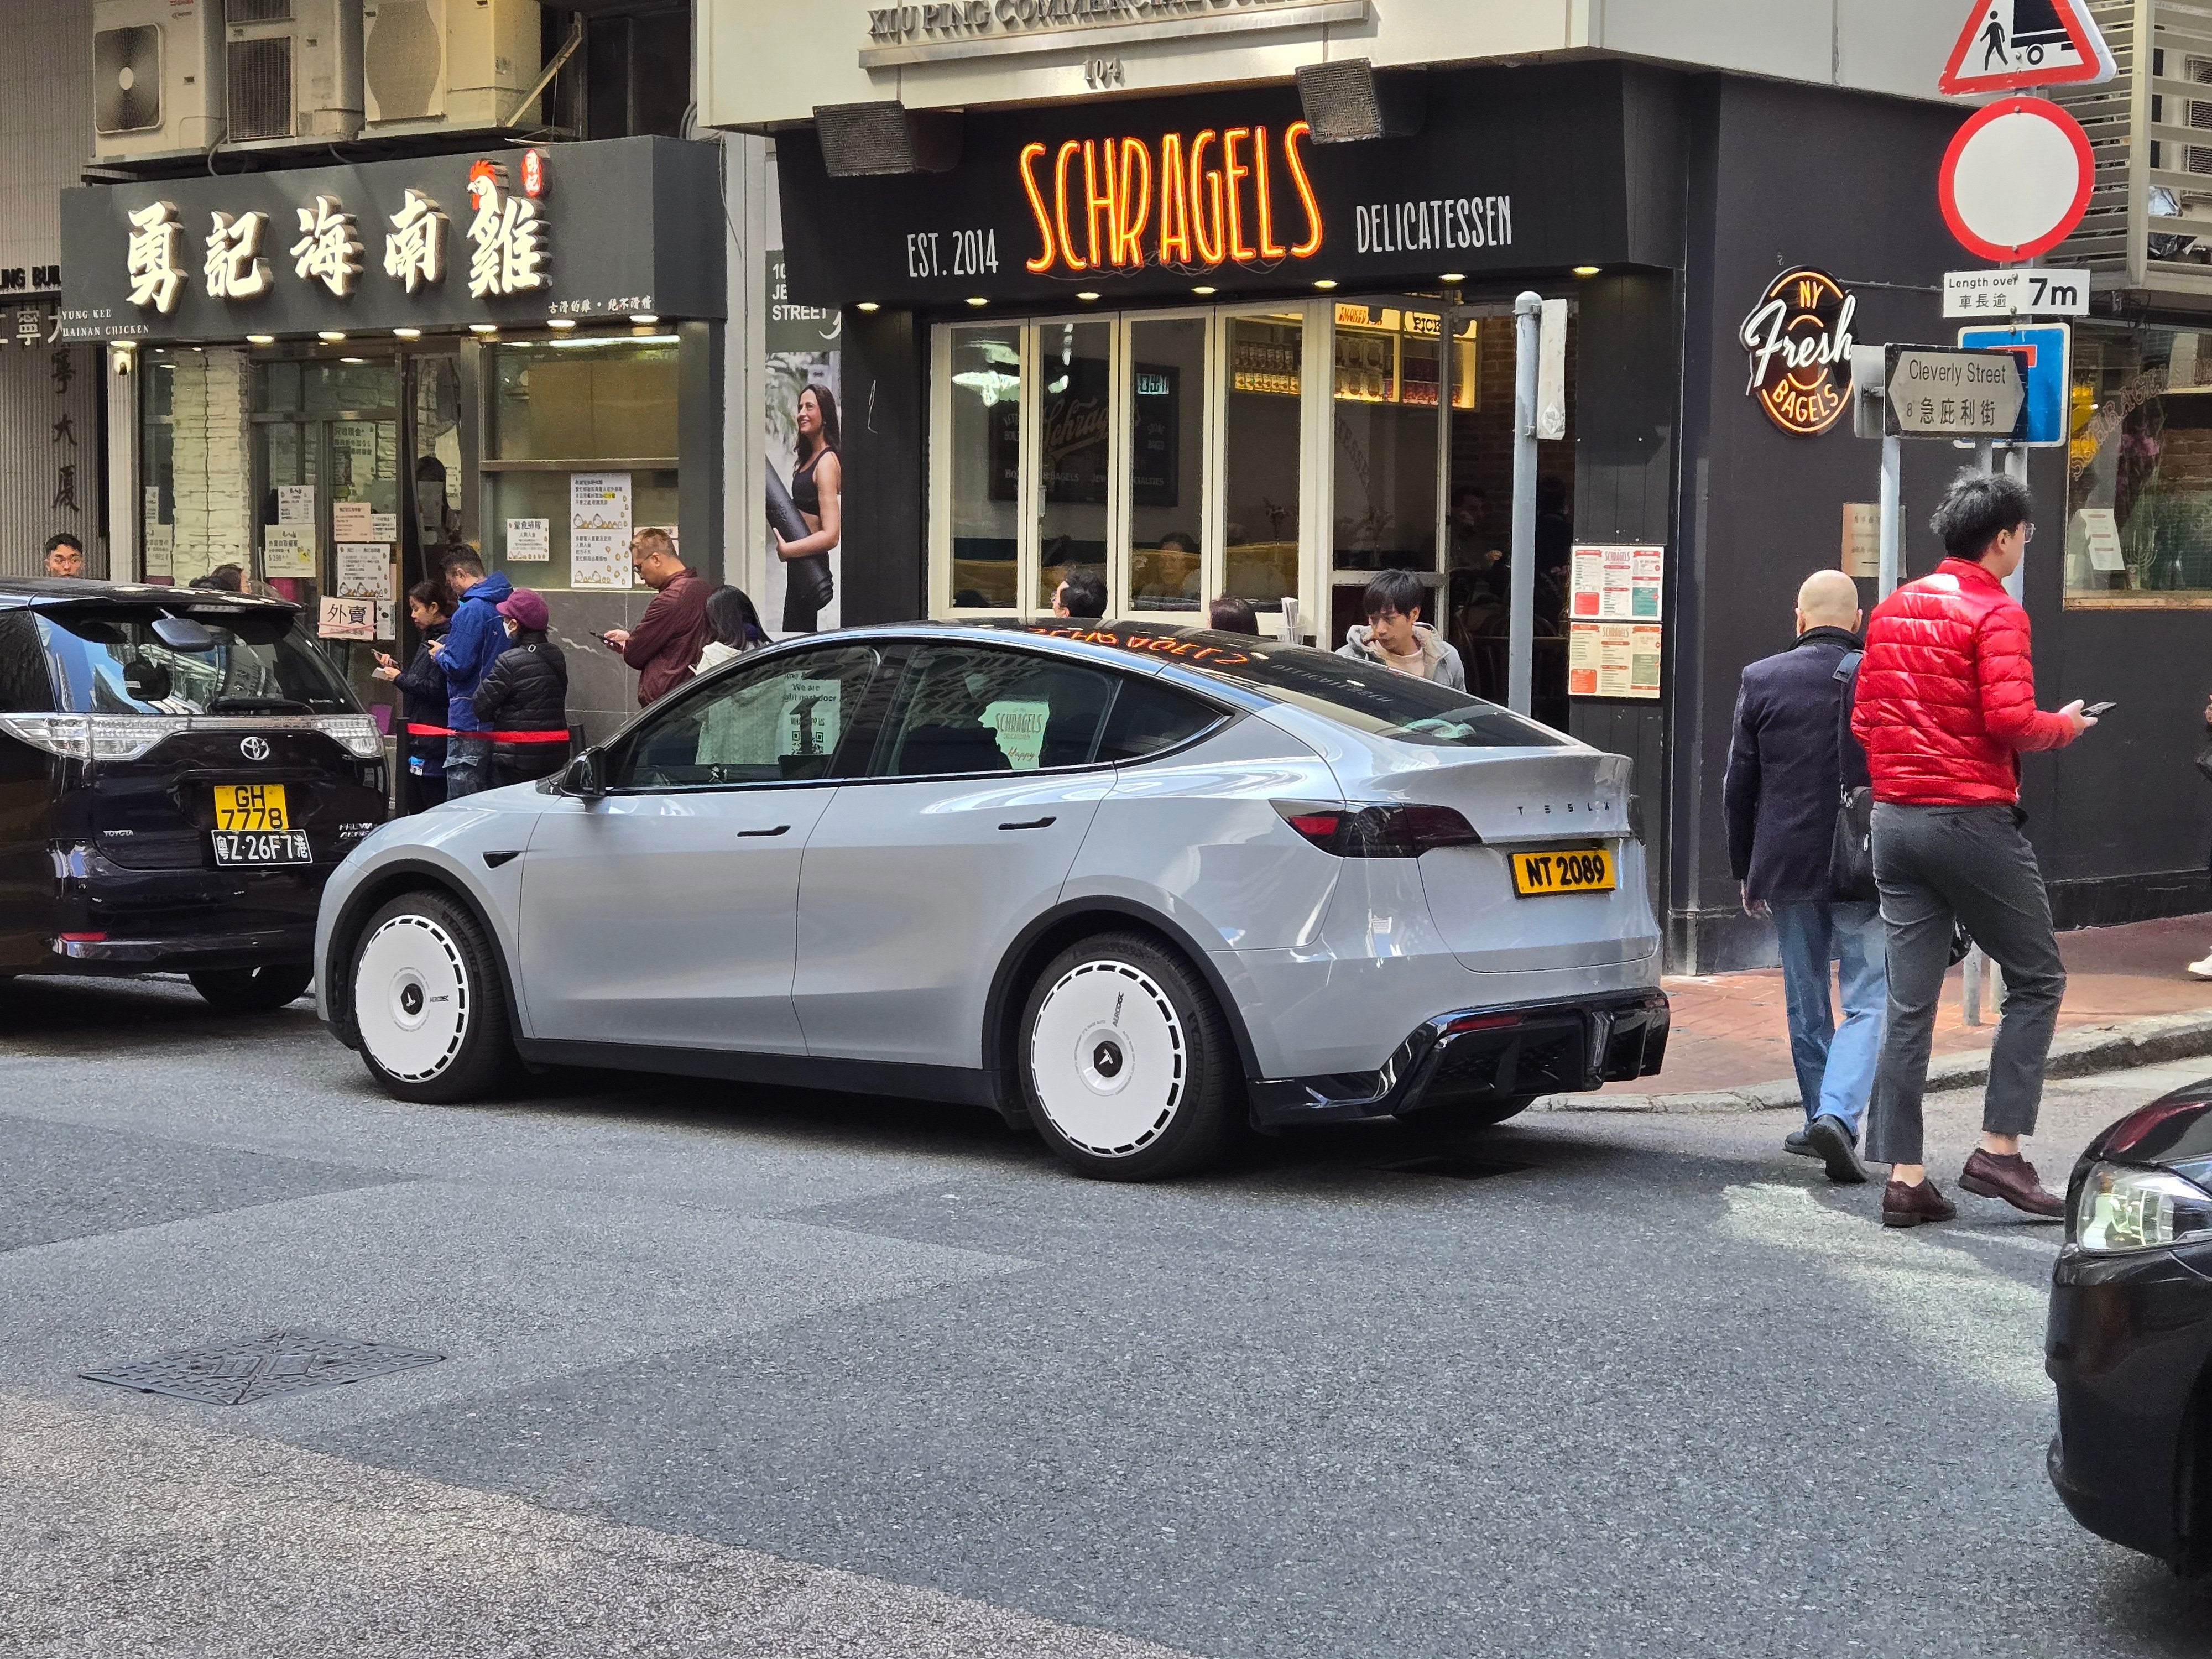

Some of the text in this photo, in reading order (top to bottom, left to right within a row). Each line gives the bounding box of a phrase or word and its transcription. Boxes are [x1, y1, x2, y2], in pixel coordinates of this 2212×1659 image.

[868, 5, 916, 34] XIU
[922, 0, 990, 29] PING
[1082, 57, 1121, 80] 104
[1020, 120, 1323, 273] SCHRAGELS
[1356, 195, 1512, 254] DELICATESSEN
[126, 188, 541, 314] 勇記海南雞
[907, 228, 999, 278] EST. 2014
[1799, 280, 1824, 309] NY
[1949, 278, 2077, 306] Length over 7m
[1959, 293, 2007, 309] 車長逾
[62, 309, 111, 320] YUNG KEE
[772, 305, 826, 321] STREET
[1413, 316, 1441, 332] PICK
[62, 324, 149, 337] HAINAN CHICKEN
[1744, 294, 1856, 388] Fresh
[1910, 359, 2006, 387] Cleverly Street
[1772, 378, 1839, 422] BAGELS
[1907, 397, 1995, 426] 8 急庇利街
[327, 604, 367, 625] 外賣
[996, 713, 1042, 733] SCHRAGELS
[235, 786, 265, 807] GH
[1517, 801, 1609, 815] TESLA
[221, 808, 283, 830] 7778
[1525, 854, 1604, 888] NT 2089
